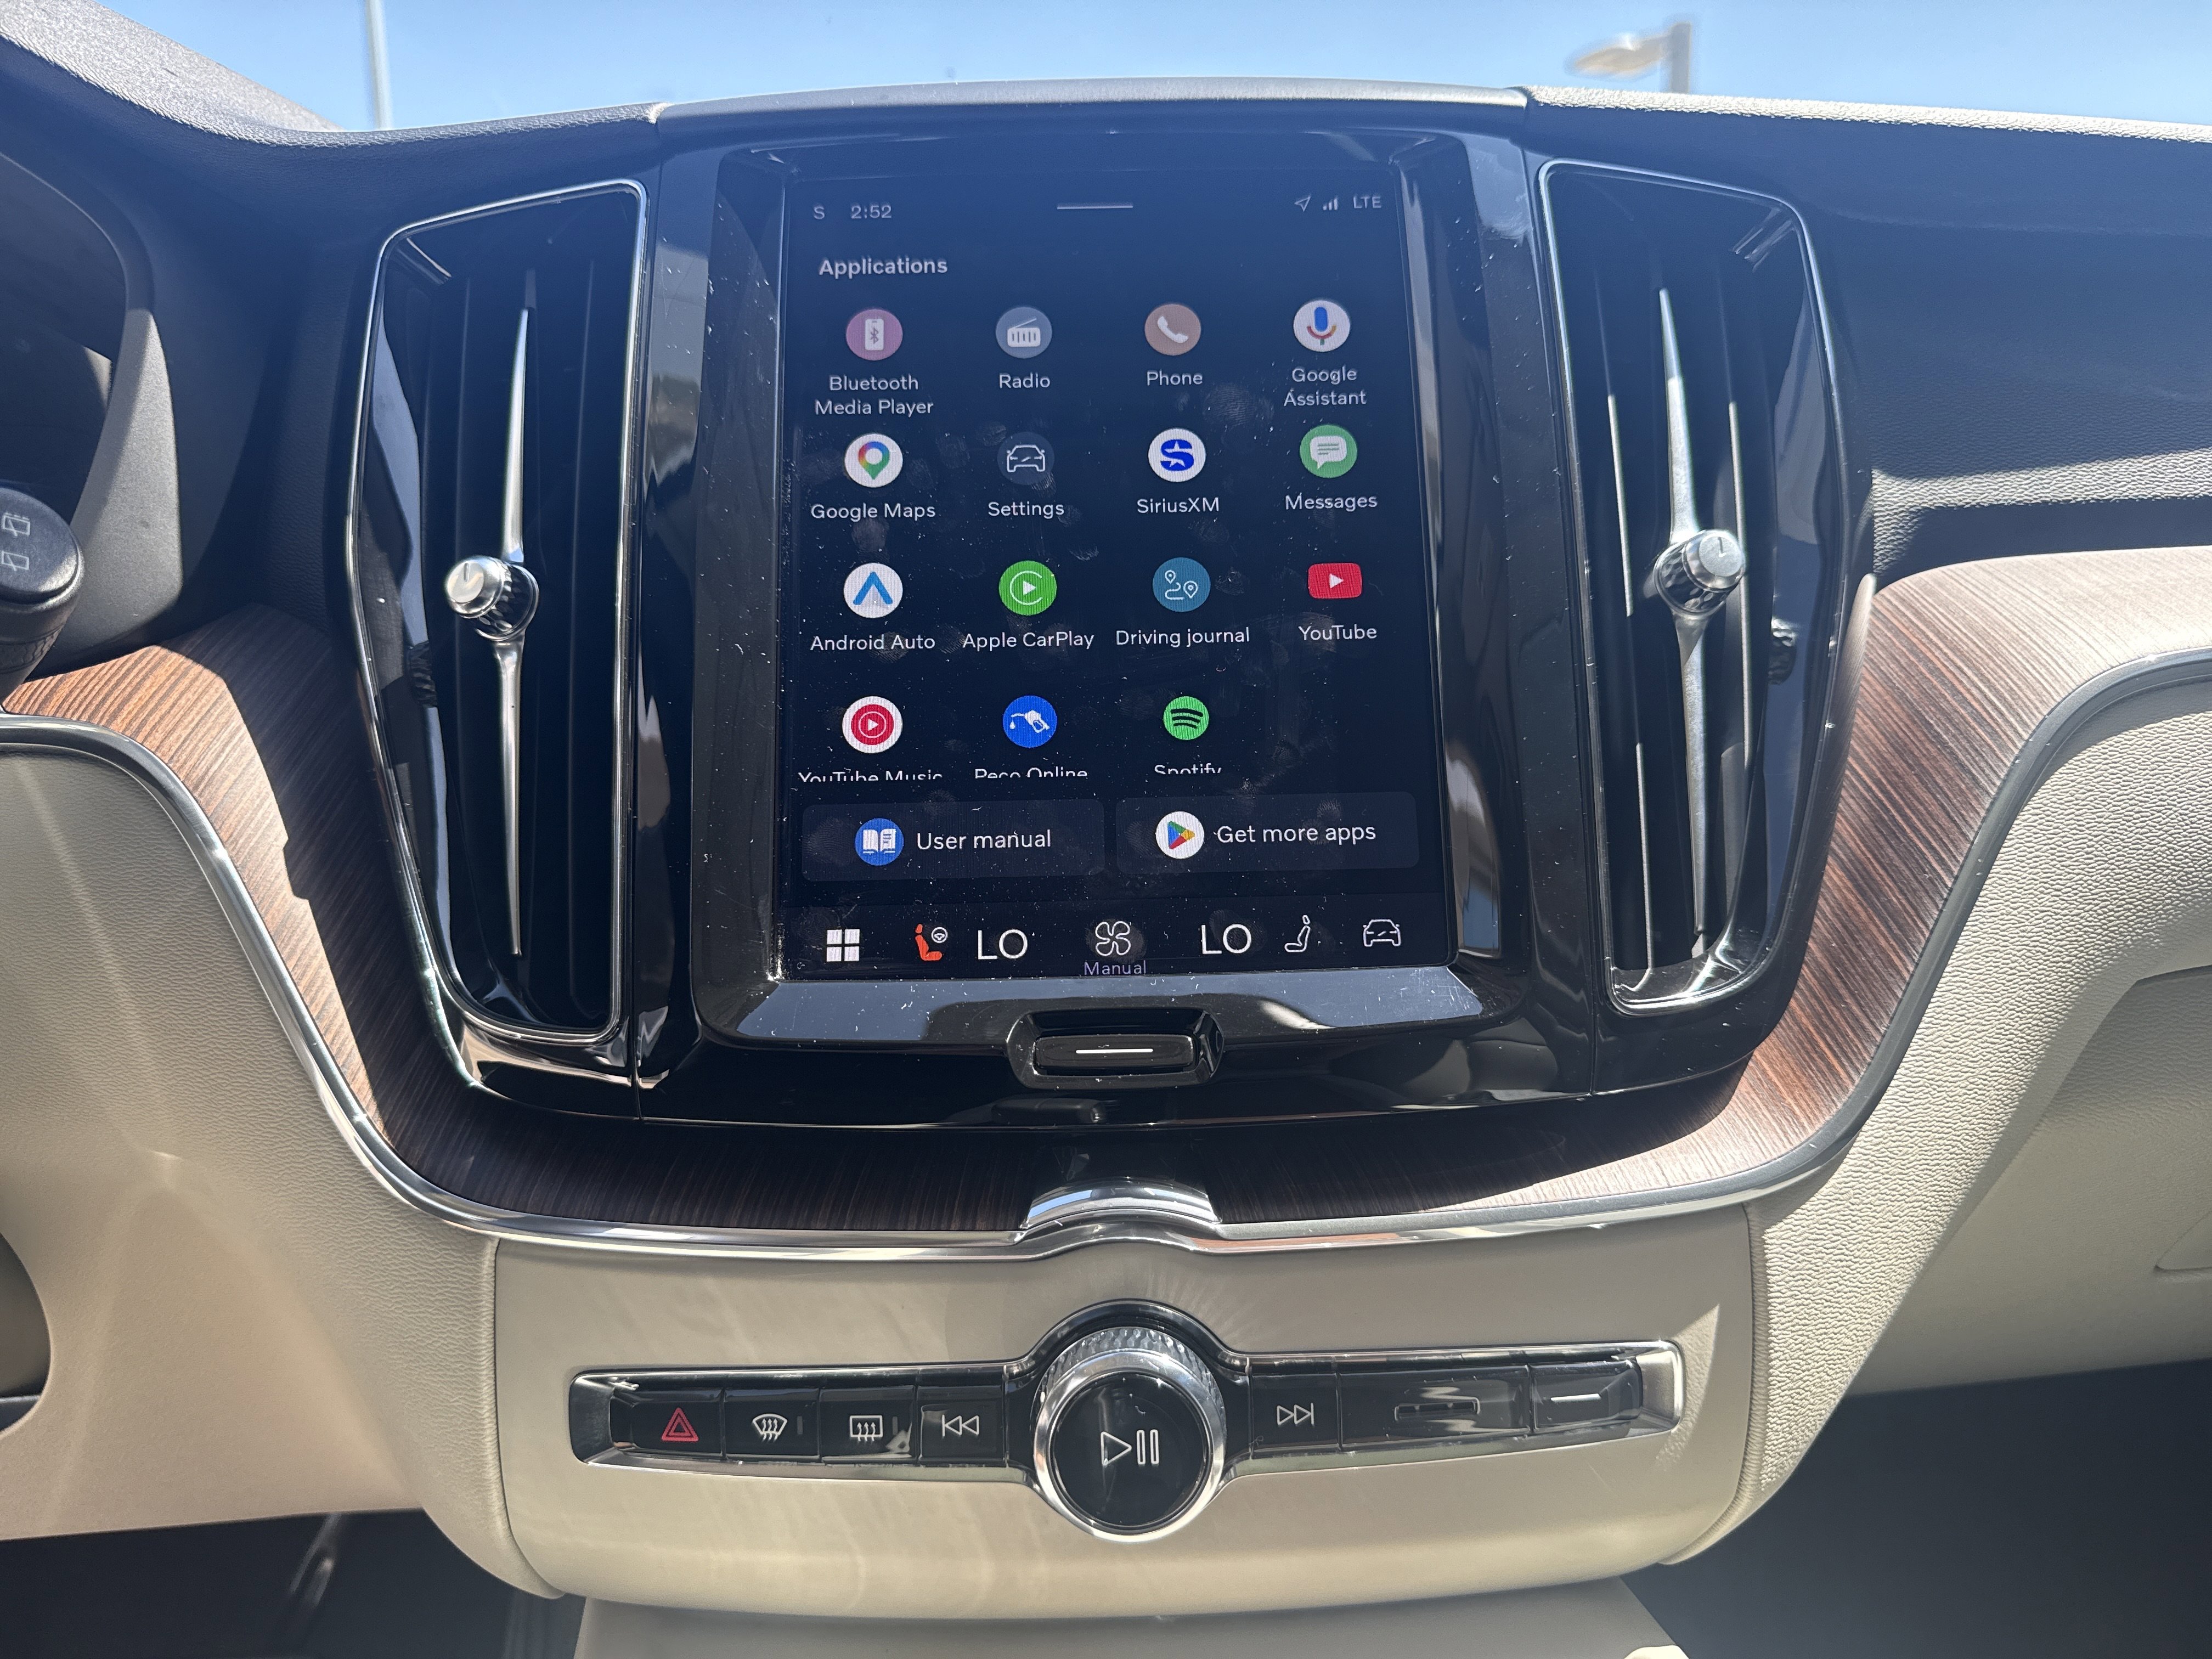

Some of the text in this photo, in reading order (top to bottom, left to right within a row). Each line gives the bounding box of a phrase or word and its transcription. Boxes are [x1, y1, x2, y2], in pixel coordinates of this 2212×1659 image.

[1353, 196, 1381, 208] LTE
[814, 205, 891, 219] S 2:52
[820, 257, 947, 279] Applications
[830, 375, 918, 390] Bluetooth
[1000, 373, 1050, 388] Radio
[1147, 371, 1203, 385] Phone
[1293, 366, 1356, 385] Google
[1284, 389, 1365, 406] Assistant
[816, 399, 933, 417] Media Player
[989, 501, 1064, 519] Settings
[1137, 497, 1218, 513] SiriusXM
[1286, 493, 1377, 511] Messages
[811, 503, 935, 522] Google Maps
[963, 631, 1094, 651] Apple CarPlay
[1116, 627, 1249, 647] Driving journal
[1299, 624, 1376, 640] YouTube
[810, 634, 935, 650] Android Auto
[917, 830, 1050, 850] User manual
[1217, 826, 1376, 845] Get more apps
[978, 929, 1028, 960] LO
[1201, 924, 1251, 954] LO
[1084, 960, 1146, 975] Manual
